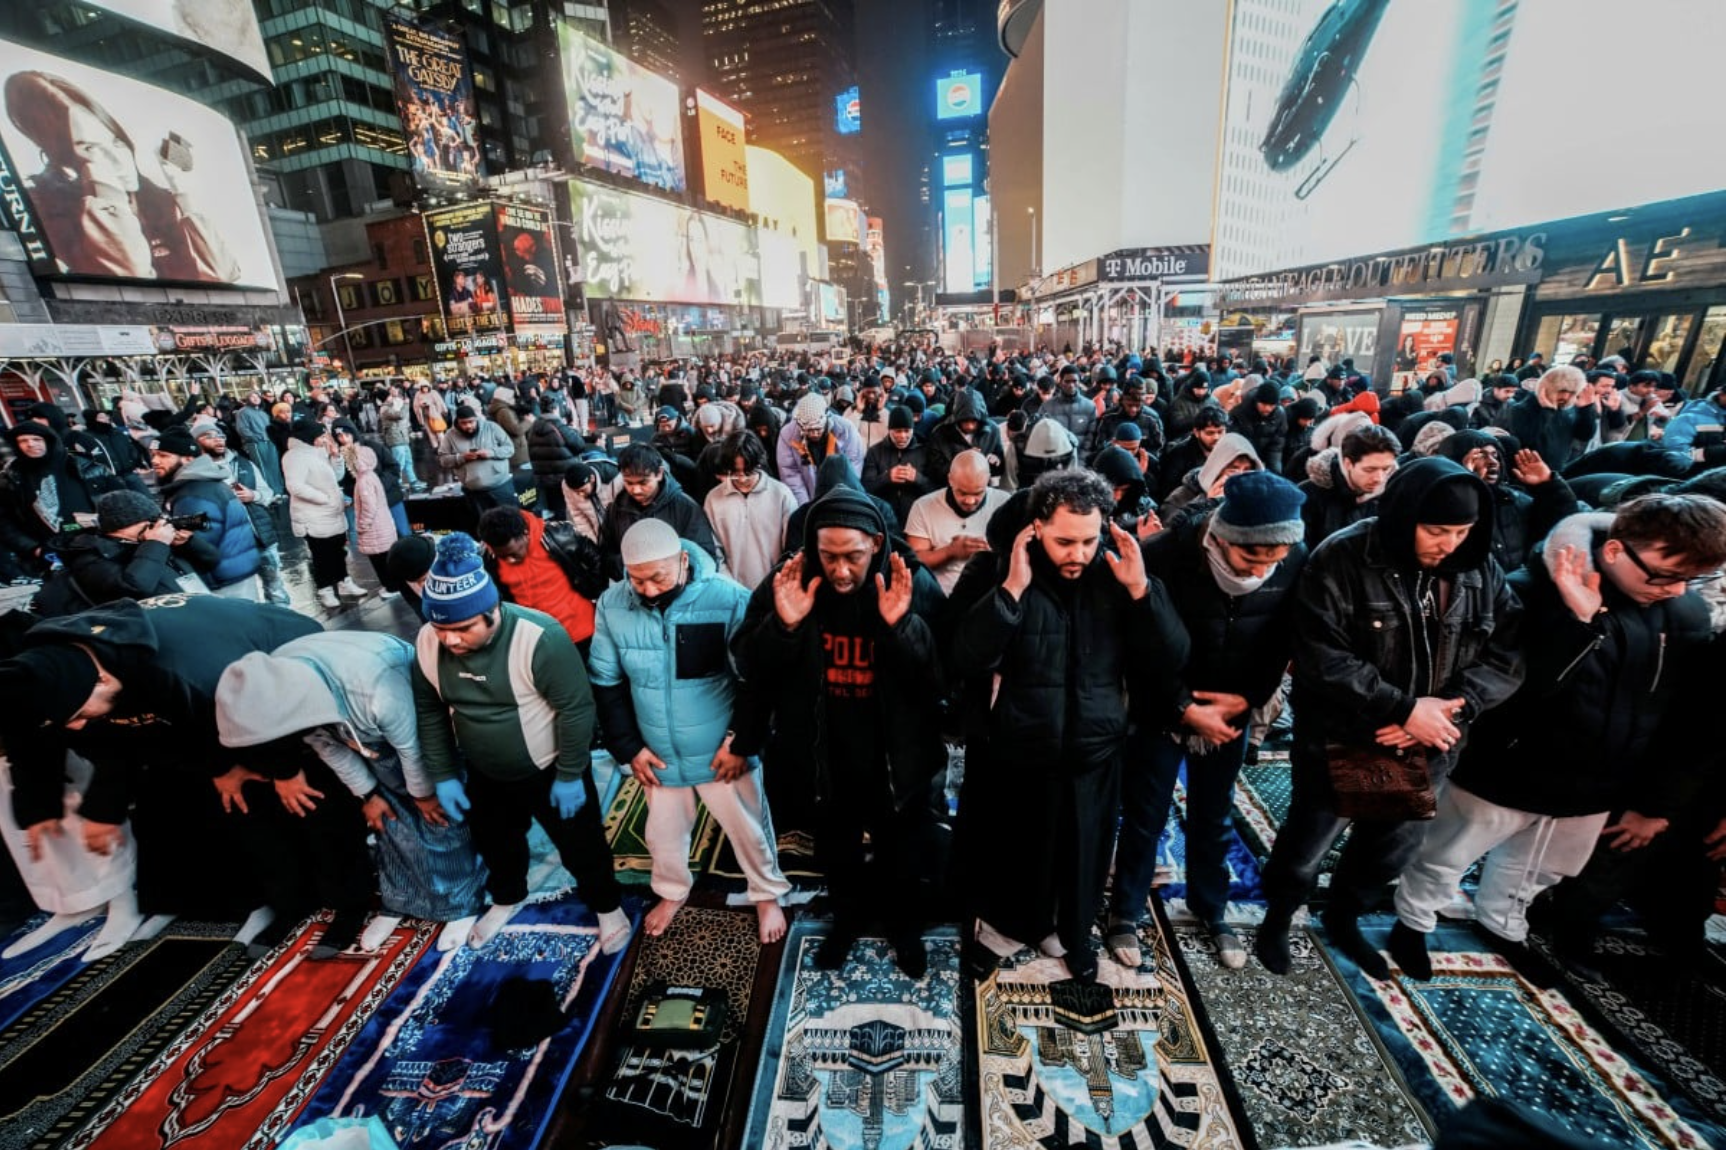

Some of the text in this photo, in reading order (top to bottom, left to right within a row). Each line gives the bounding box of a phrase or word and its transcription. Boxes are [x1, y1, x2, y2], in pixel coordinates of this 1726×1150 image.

[395, 44, 421, 67] THE
[421, 54, 462, 78] GREAT
[408, 65, 458, 91] GATSBY
[715, 125, 737, 145] FACE
[732, 160, 747, 177] THE
[720, 168, 749, 190] FUTURE
[446, 237, 486, 254] strangers
[447, 231, 463, 244] two
[1125, 255, 1187, 277] Mobile
[1287, 264, 1346, 296] EAGLE
[1346, 231, 1548, 290] OUTFITTERS
[153, 309, 238, 324] EXPRSS
[490, 312, 508, 325] YER
[1404, 310, 1458, 321] NEED MEDS?
[461, 335, 498, 351] LUGAGE
[1301, 327, 1378, 356] LVE
[822, 632, 875, 668] POL
